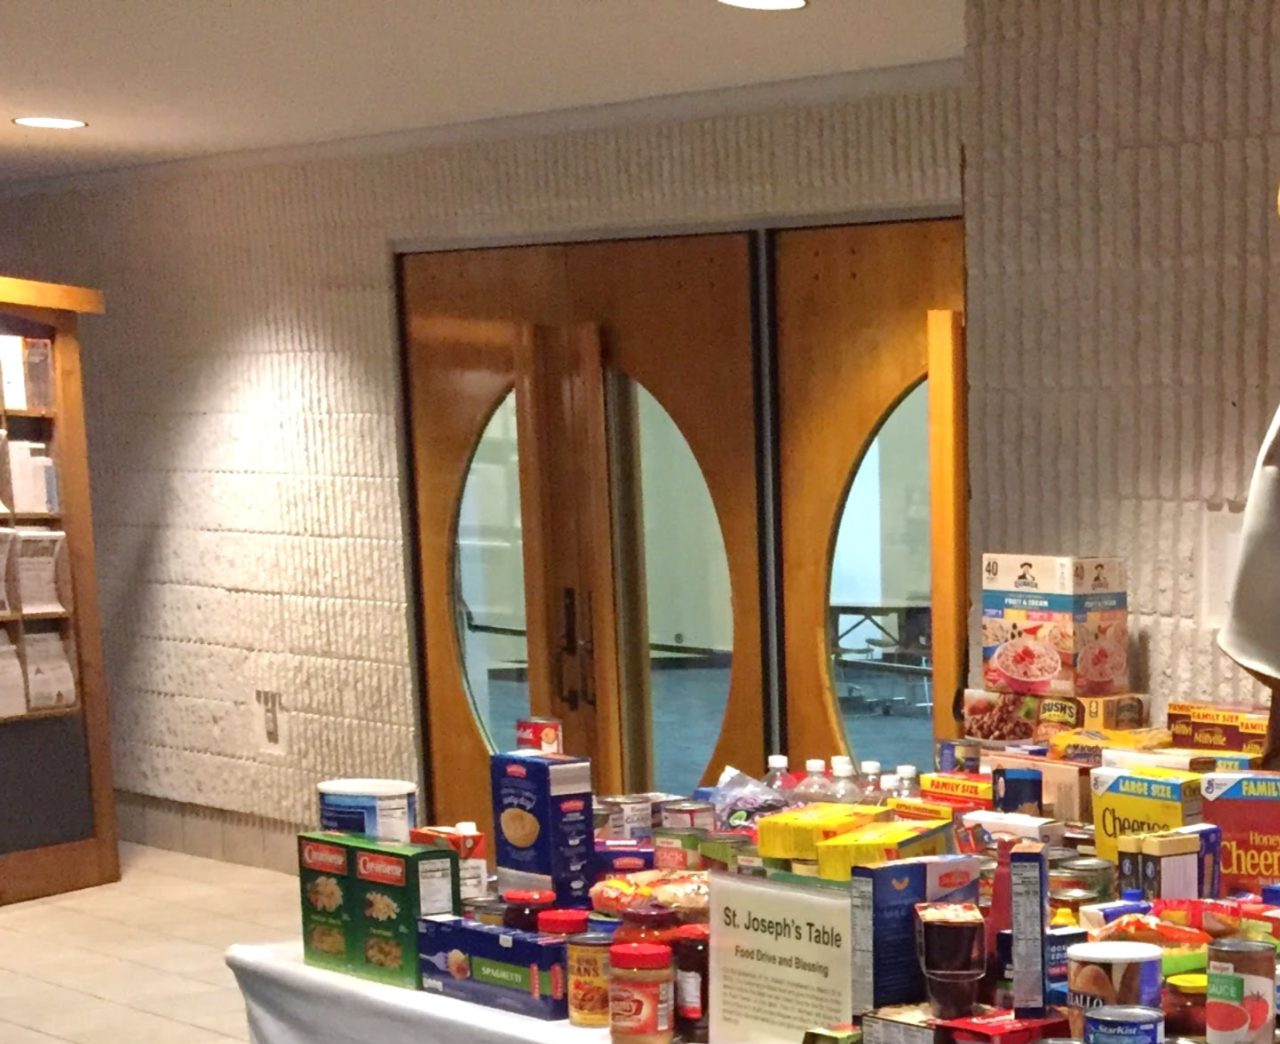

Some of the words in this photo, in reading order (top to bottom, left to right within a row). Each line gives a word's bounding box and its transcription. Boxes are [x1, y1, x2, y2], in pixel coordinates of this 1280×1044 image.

[985, 561, 998, 577] 40
[1042, 702, 1075, 719] BUSH'S
[930, 780, 959, 792] FAMILY
[961, 783, 980, 795] SIZE
[1119, 778, 1149, 796] LARGE
[1150, 783, 1172, 800] SIZE
[723, 906, 741, 929] St.
[744, 910, 802, 941] Joseph's
[805, 921, 842, 949] Table
[734, 945, 755, 960] Food
[756, 949, 777, 965] Drive
[778, 956, 793, 969] and
[794, 956, 829, 979] Blessing
[480, 965, 523, 984] SPAGHETTI
[1097, 1023, 1137, 1036] StarKist
